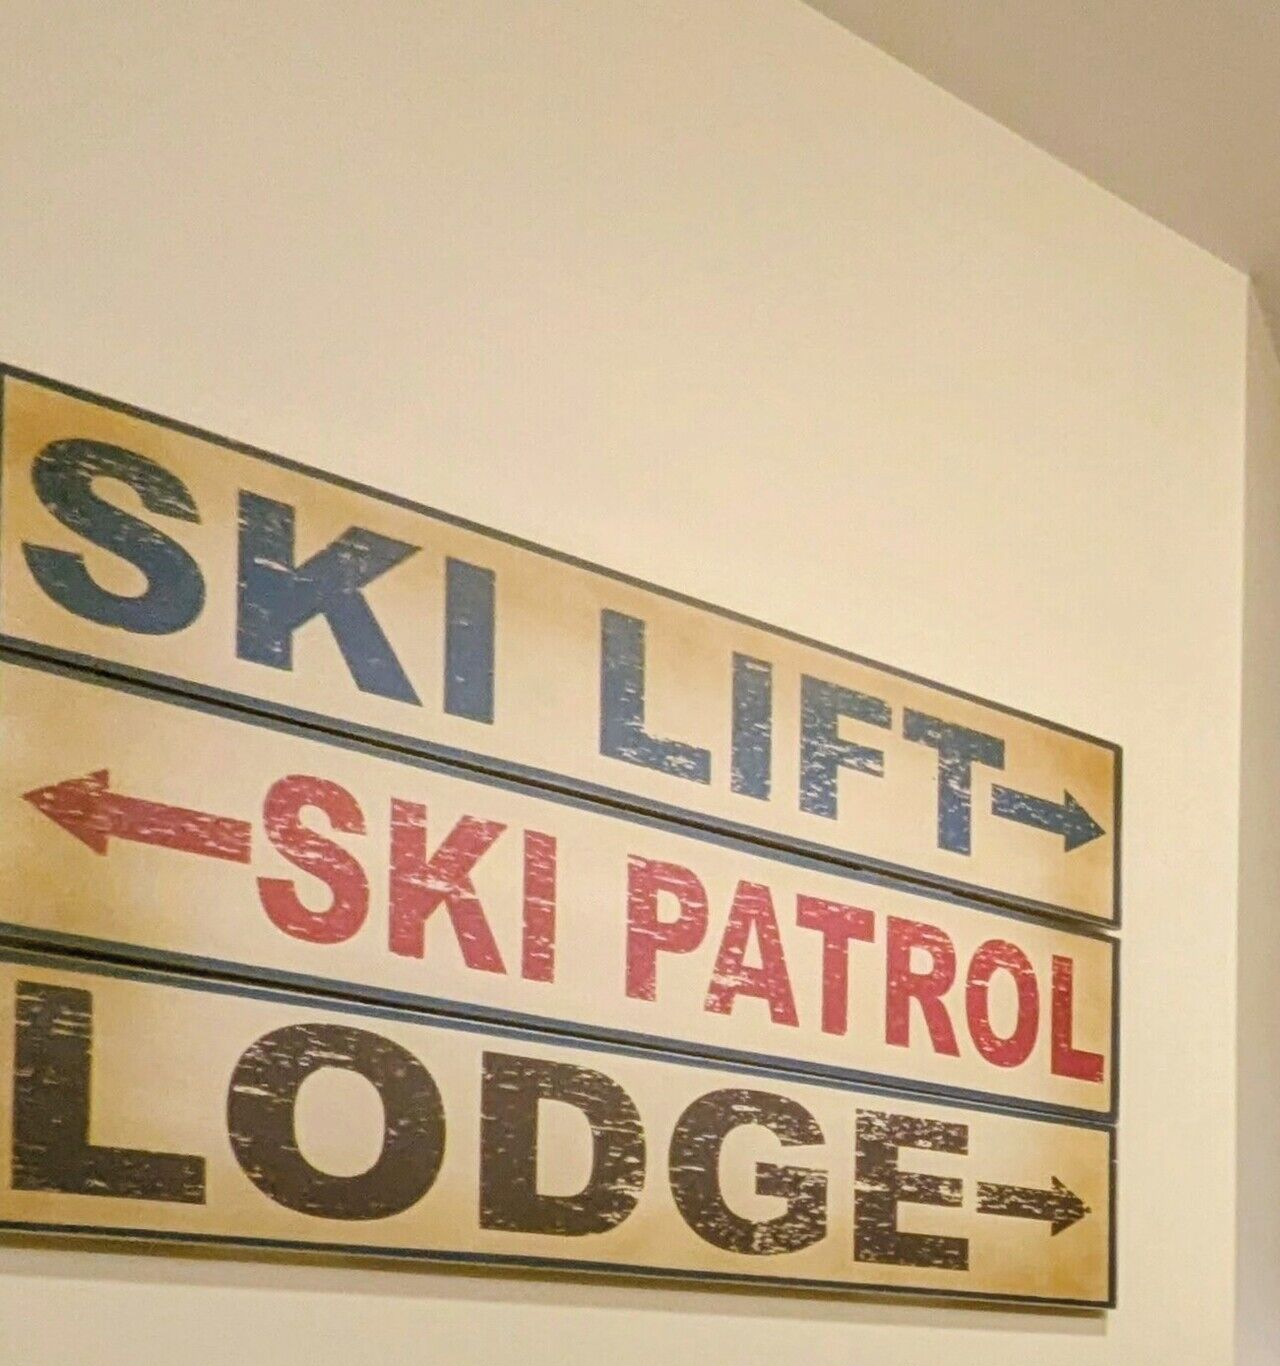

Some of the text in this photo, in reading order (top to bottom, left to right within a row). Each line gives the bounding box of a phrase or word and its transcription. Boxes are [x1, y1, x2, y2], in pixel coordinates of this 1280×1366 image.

[20, 436, 1005, 857] SKI LIFT
[256, 773, 1105, 1084] SKI PATROL
[10, 981, 970, 1272] LODGE
